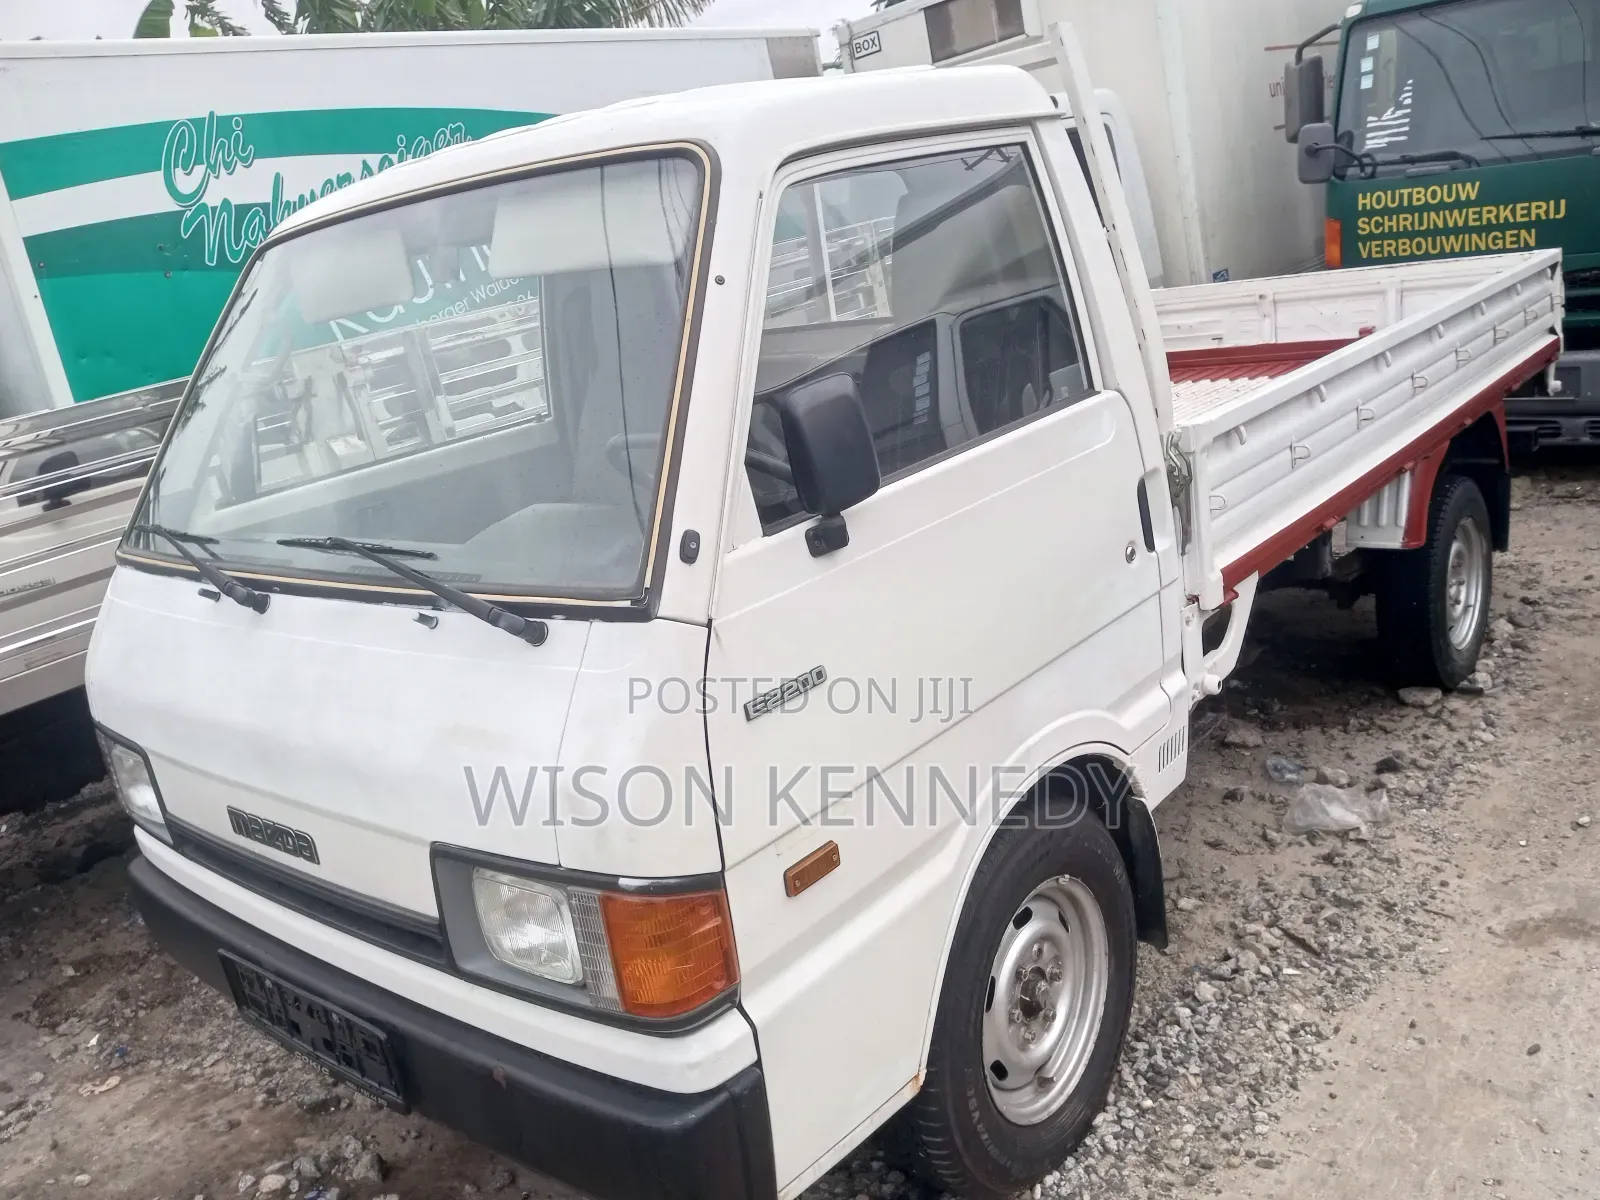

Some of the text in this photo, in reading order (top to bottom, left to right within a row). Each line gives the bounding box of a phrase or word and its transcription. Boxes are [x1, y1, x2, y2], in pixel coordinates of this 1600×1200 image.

[854, 35, 878, 54] BOX
[1357, 181, 1480, 211] HOUTBOUW
[1357, 199, 1566, 236] SCHRIJNWERKERIJ
[1358, 229, 1537, 259] VERBOUWINGEN
[744, 665, 827, 722] E2200
